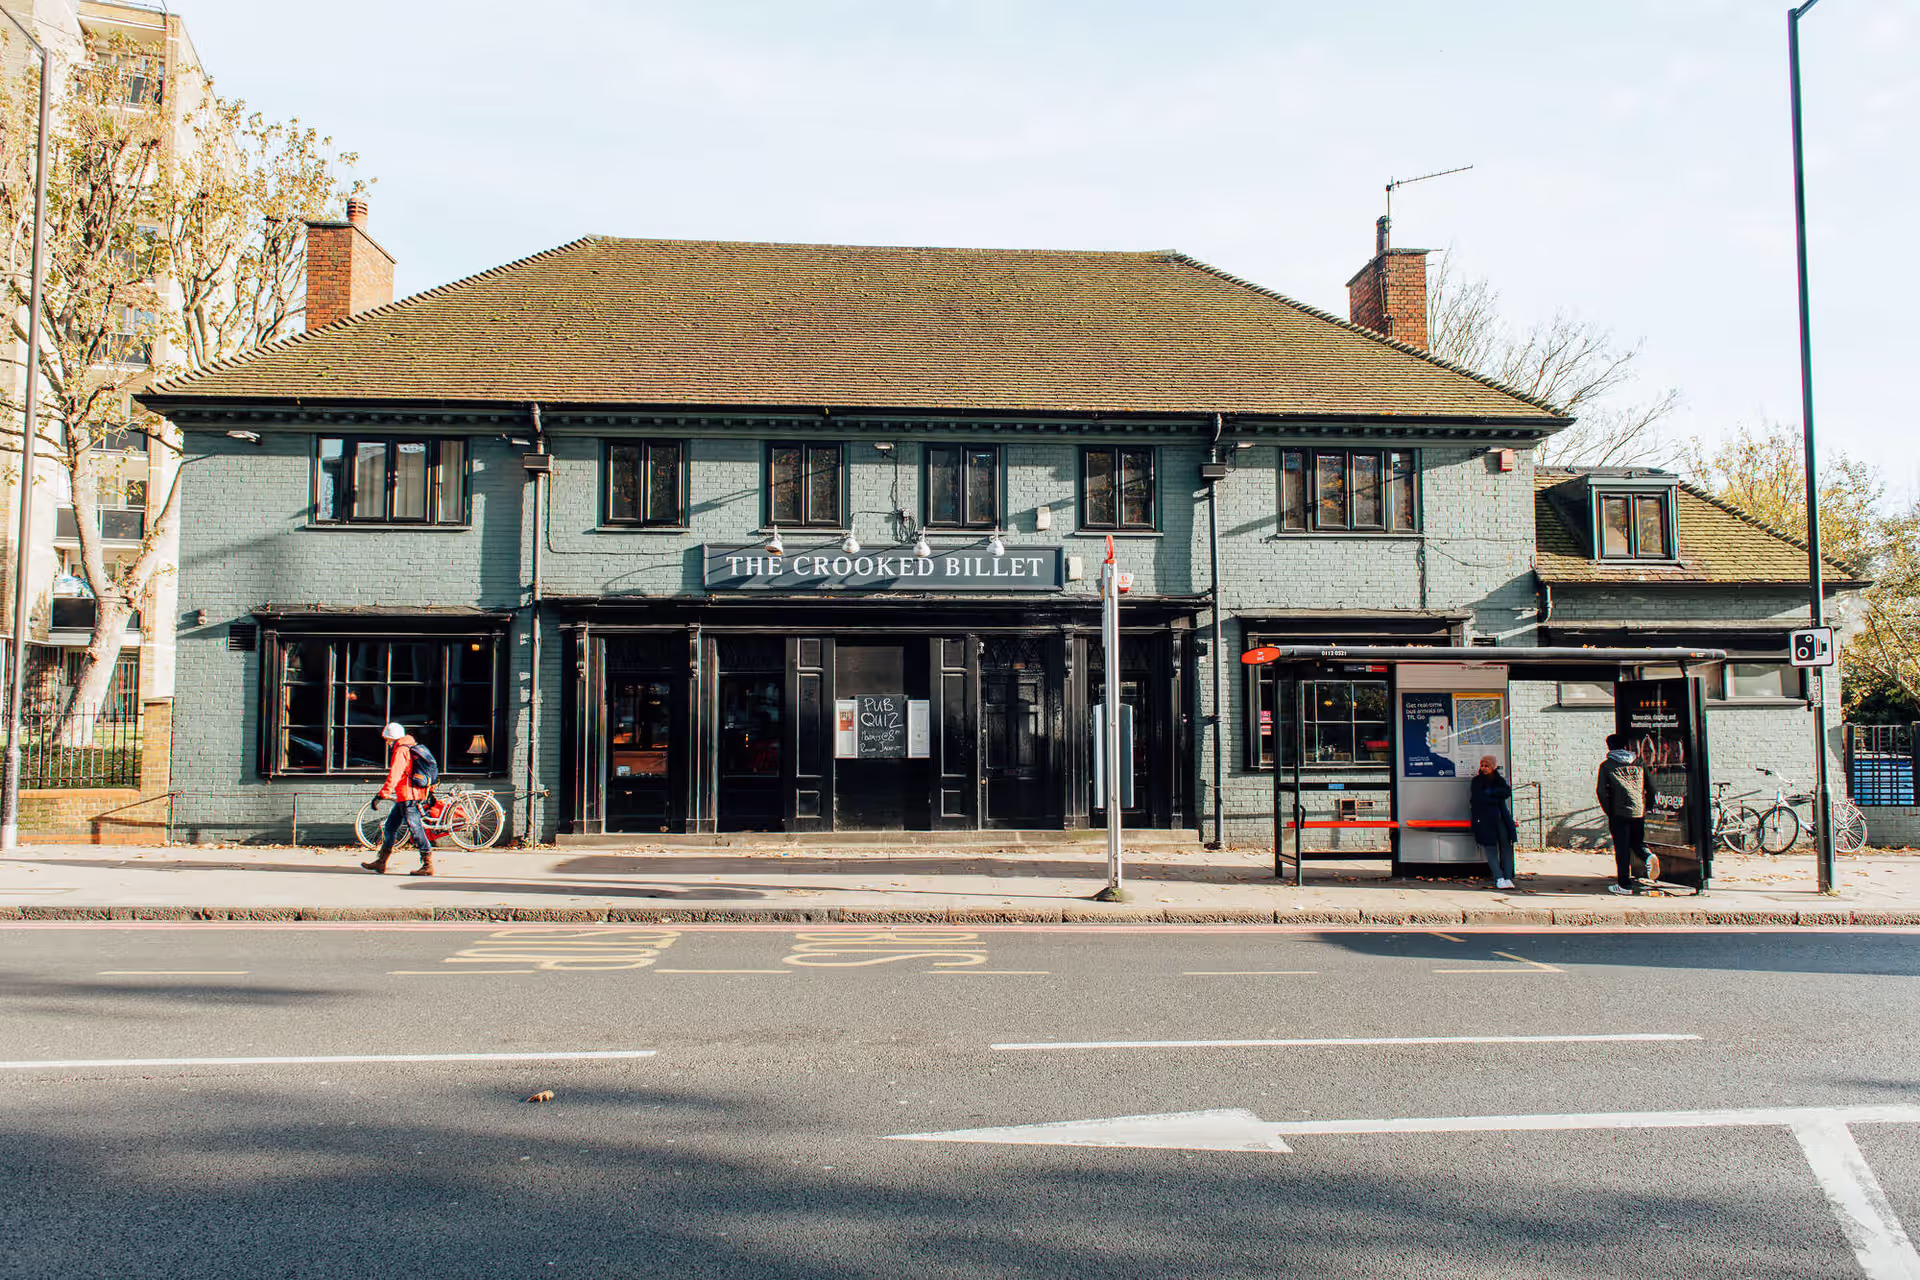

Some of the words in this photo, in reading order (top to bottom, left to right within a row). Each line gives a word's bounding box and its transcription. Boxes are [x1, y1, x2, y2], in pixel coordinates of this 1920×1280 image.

[726, 556, 783, 577] THE
[793, 555, 934, 578] CROOKED
[945, 556, 1044, 577] BILLET
[864, 698, 894, 712] PUB
[860, 712, 904, 729] QUIZ
[1654, 791, 1685, 810] Voyage
[443, 929, 682, 970] STOP
[781, 932, 988, 967] BUS
